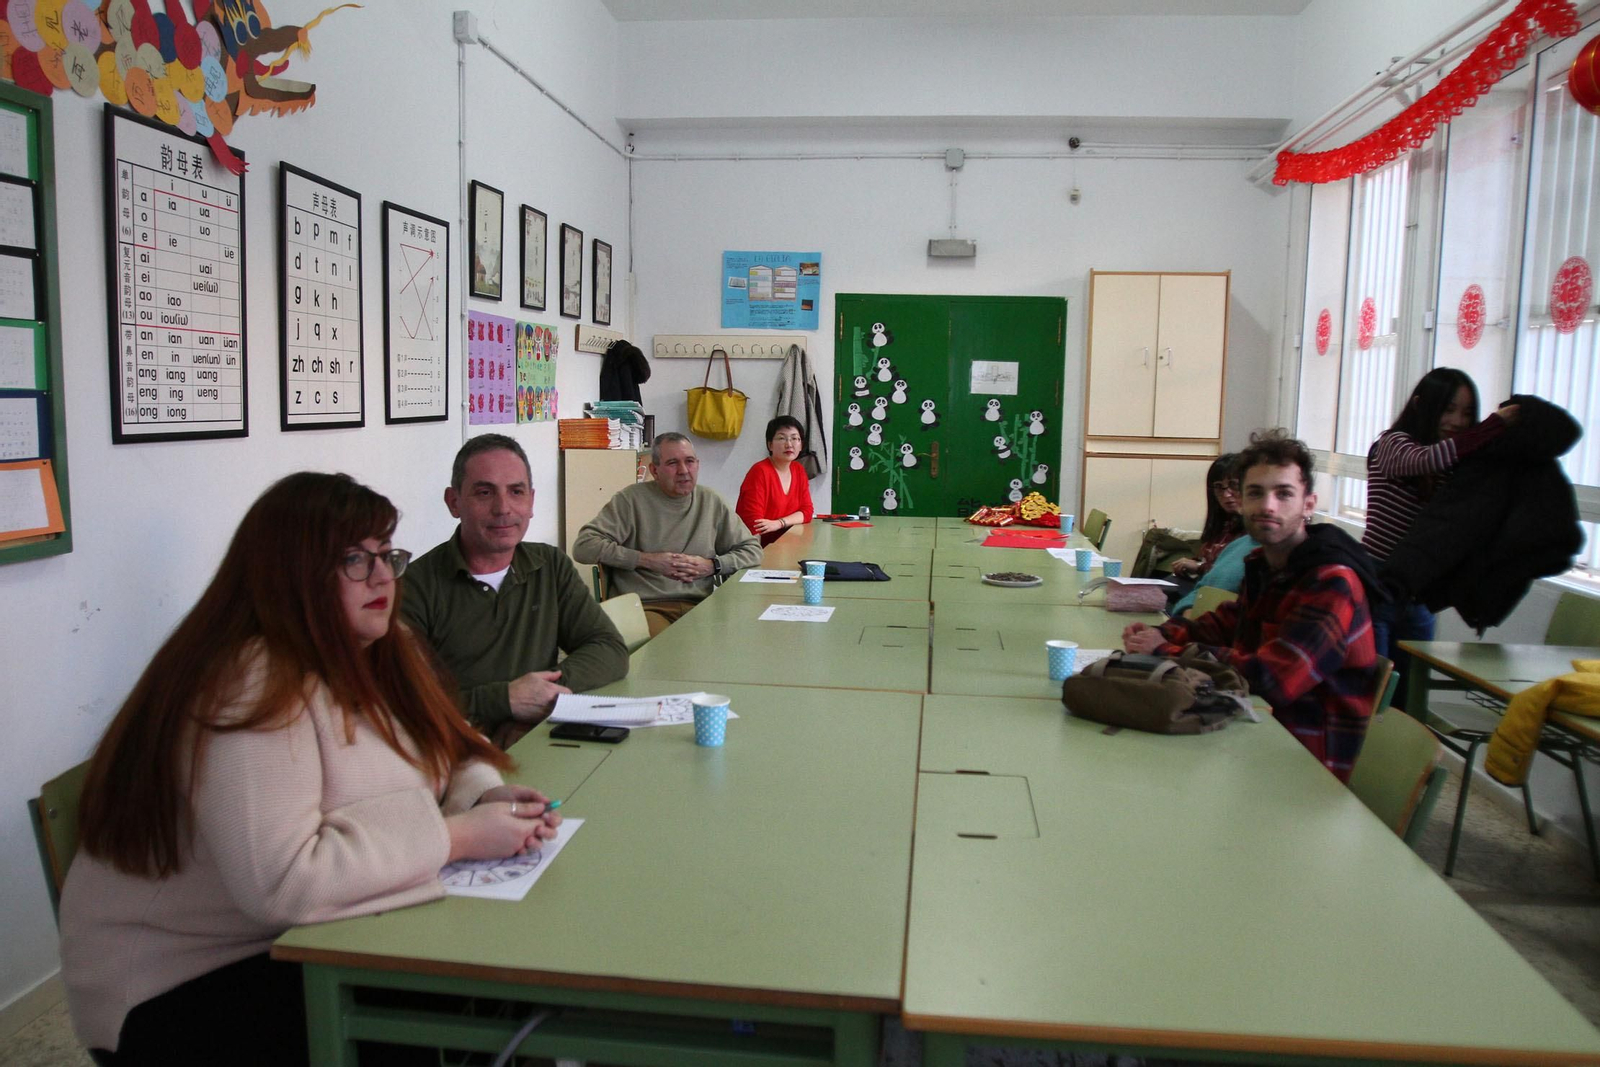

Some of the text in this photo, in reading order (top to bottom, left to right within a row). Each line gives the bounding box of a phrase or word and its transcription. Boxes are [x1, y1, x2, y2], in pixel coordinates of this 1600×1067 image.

[161, 144, 203, 180] 韵母表
[171, 179, 231, 207] i u ü
[141, 192, 210, 217] a ia ua
[141, 213, 210, 236] o uo
[295, 216, 351, 251] b p m f
[142, 232, 234, 258] e ie üe
[141, 252, 212, 274] ai uai
[295, 252, 301, 270] d
[315, 257, 319, 273] t
[332, 263, 337, 276] n
[142, 271, 218, 293] ei uei(ui)
[140, 291, 181, 306] ao iao
[295, 285, 337, 310] g k h
[140, 311, 188, 326] ou iou(iu)
[297, 318, 337, 341] j q x
[141, 331, 237, 348] an ian uan üan
[142, 351, 236, 365] en in uen(un) ün
[292, 355, 353, 374] zh ch sh r
[139, 368, 218, 383] ang iang uang
[139, 387, 218, 401] eng ing ueng
[296, 391, 338, 404] z c s
[140, 406, 186, 419] ong iong
